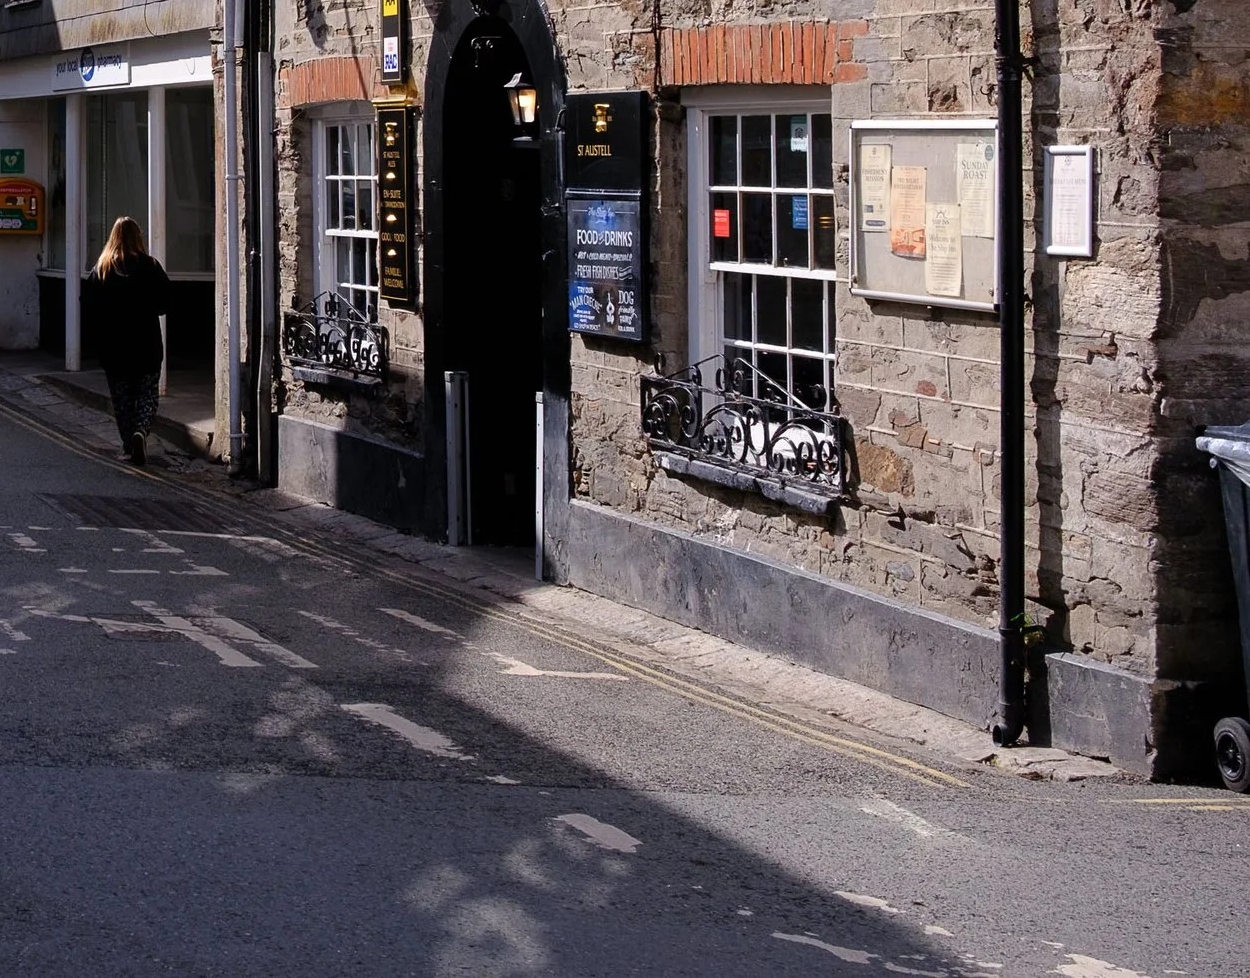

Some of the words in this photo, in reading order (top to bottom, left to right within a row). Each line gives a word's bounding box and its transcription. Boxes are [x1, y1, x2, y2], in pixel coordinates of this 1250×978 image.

[385, 53, 398, 70] RAC
[585, 144, 612, 156] AUSTELL
[961, 159, 989, 170] SUNDAY
[963, 170, 988, 180] ROAST
[577, 229, 598, 245] FOOD
[605, 230, 633, 248] DRINKS
[577, 265, 591, 279] FRESH
[592, 265, 603, 279] FISH
[618, 290, 634, 305] DOG
